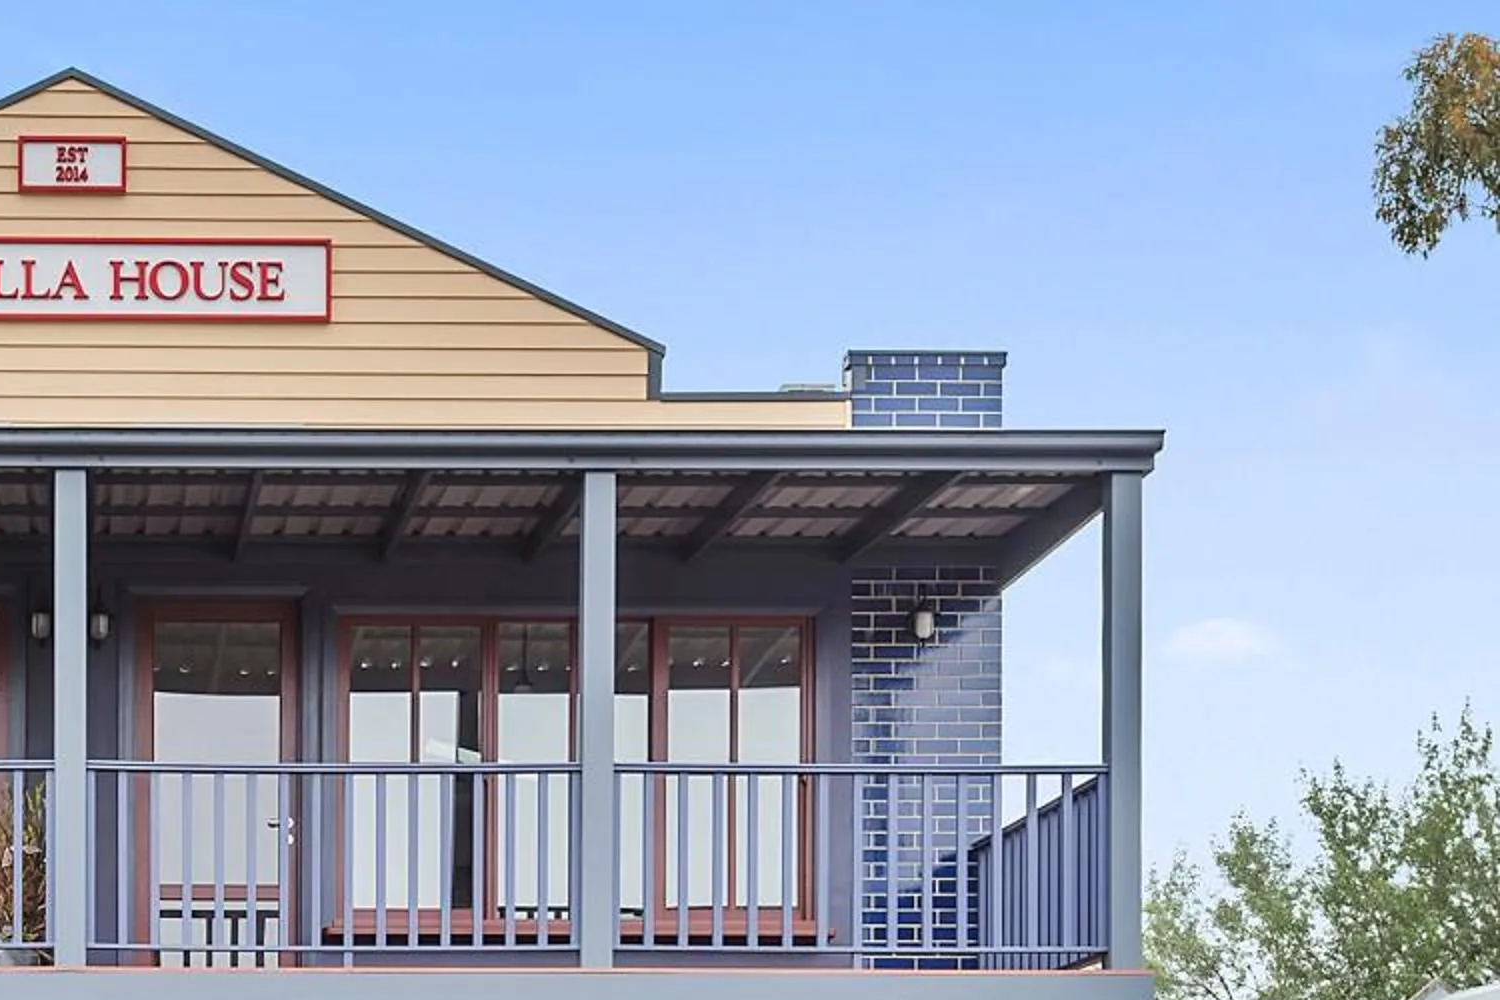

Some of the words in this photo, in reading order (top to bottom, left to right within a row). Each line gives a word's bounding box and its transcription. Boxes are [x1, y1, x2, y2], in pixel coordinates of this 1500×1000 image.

[55, 146, 89, 164] EST
[55, 166, 89, 184] 2014
[109, 259, 286, 302] HOUSE
